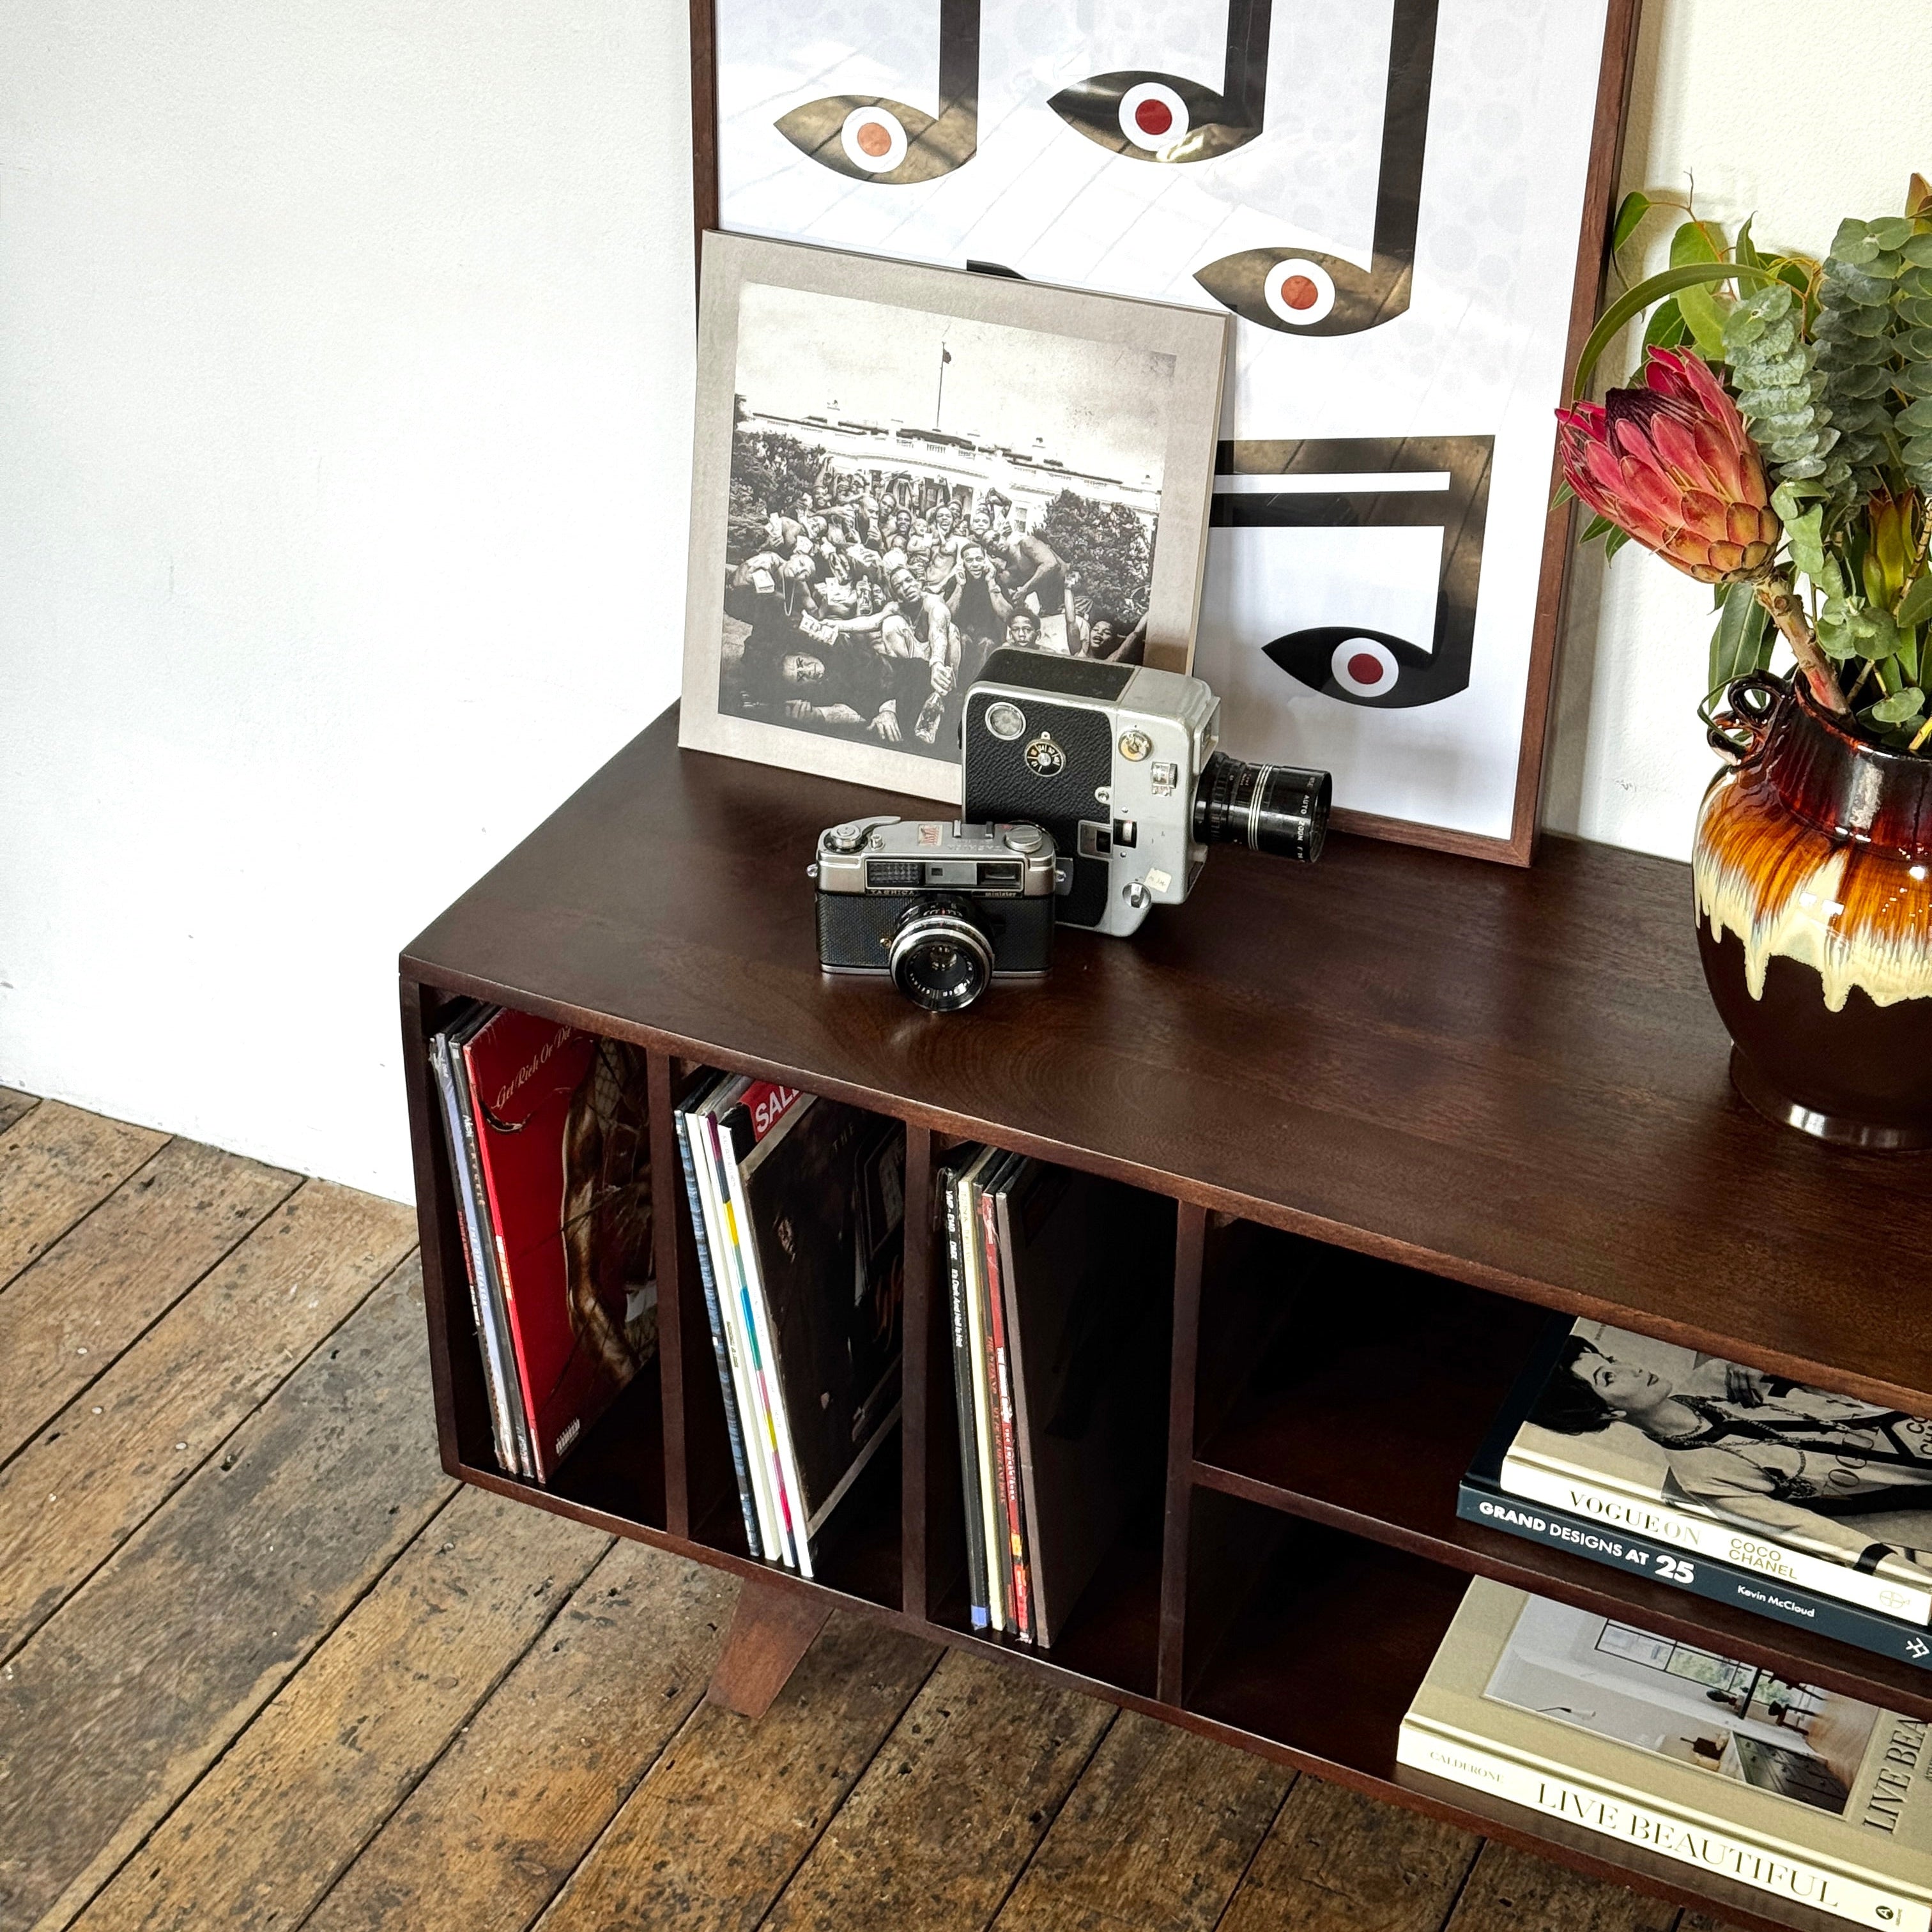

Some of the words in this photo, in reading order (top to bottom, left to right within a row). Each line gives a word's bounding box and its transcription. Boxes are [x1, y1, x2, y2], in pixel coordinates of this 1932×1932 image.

[1300, 795, 1310, 815] AUTO
[490, 1080, 515, 1110] Get
[514, 1054, 539, 1089] Rich
[540, 1042, 554, 1064] Or
[755, 1085, 801, 1133] SAL
[949, 1241, 958, 1261] DMX
[951, 1279, 960, 1297] Dark
[953, 1296, 961, 1313] And
[1569, 1489, 1660, 1533] VOGUE
[1664, 1521, 1703, 1545] ON
[1478, 1501, 1547, 1532] GRAND
[1549, 1522, 1623, 1558] DESIGNS
[1625, 1549, 1650, 1566] AT
[1654, 1554, 1695, 1585] 25
[1730, 1538, 1781, 1561] COCO
[1728, 1549, 1798, 1580] CHANEL
[1736, 1584, 1767, 1602] Kevin
[1767, 1597, 1816, 1618] McCloud
[1429, 1751, 1505, 1784] CALDERONE
[1862, 1767, 1914, 1836] LIVE
[1535, 1782, 1620, 1830] LIVE
[1627, 1813, 1840, 1908] BEAUTIFUL
